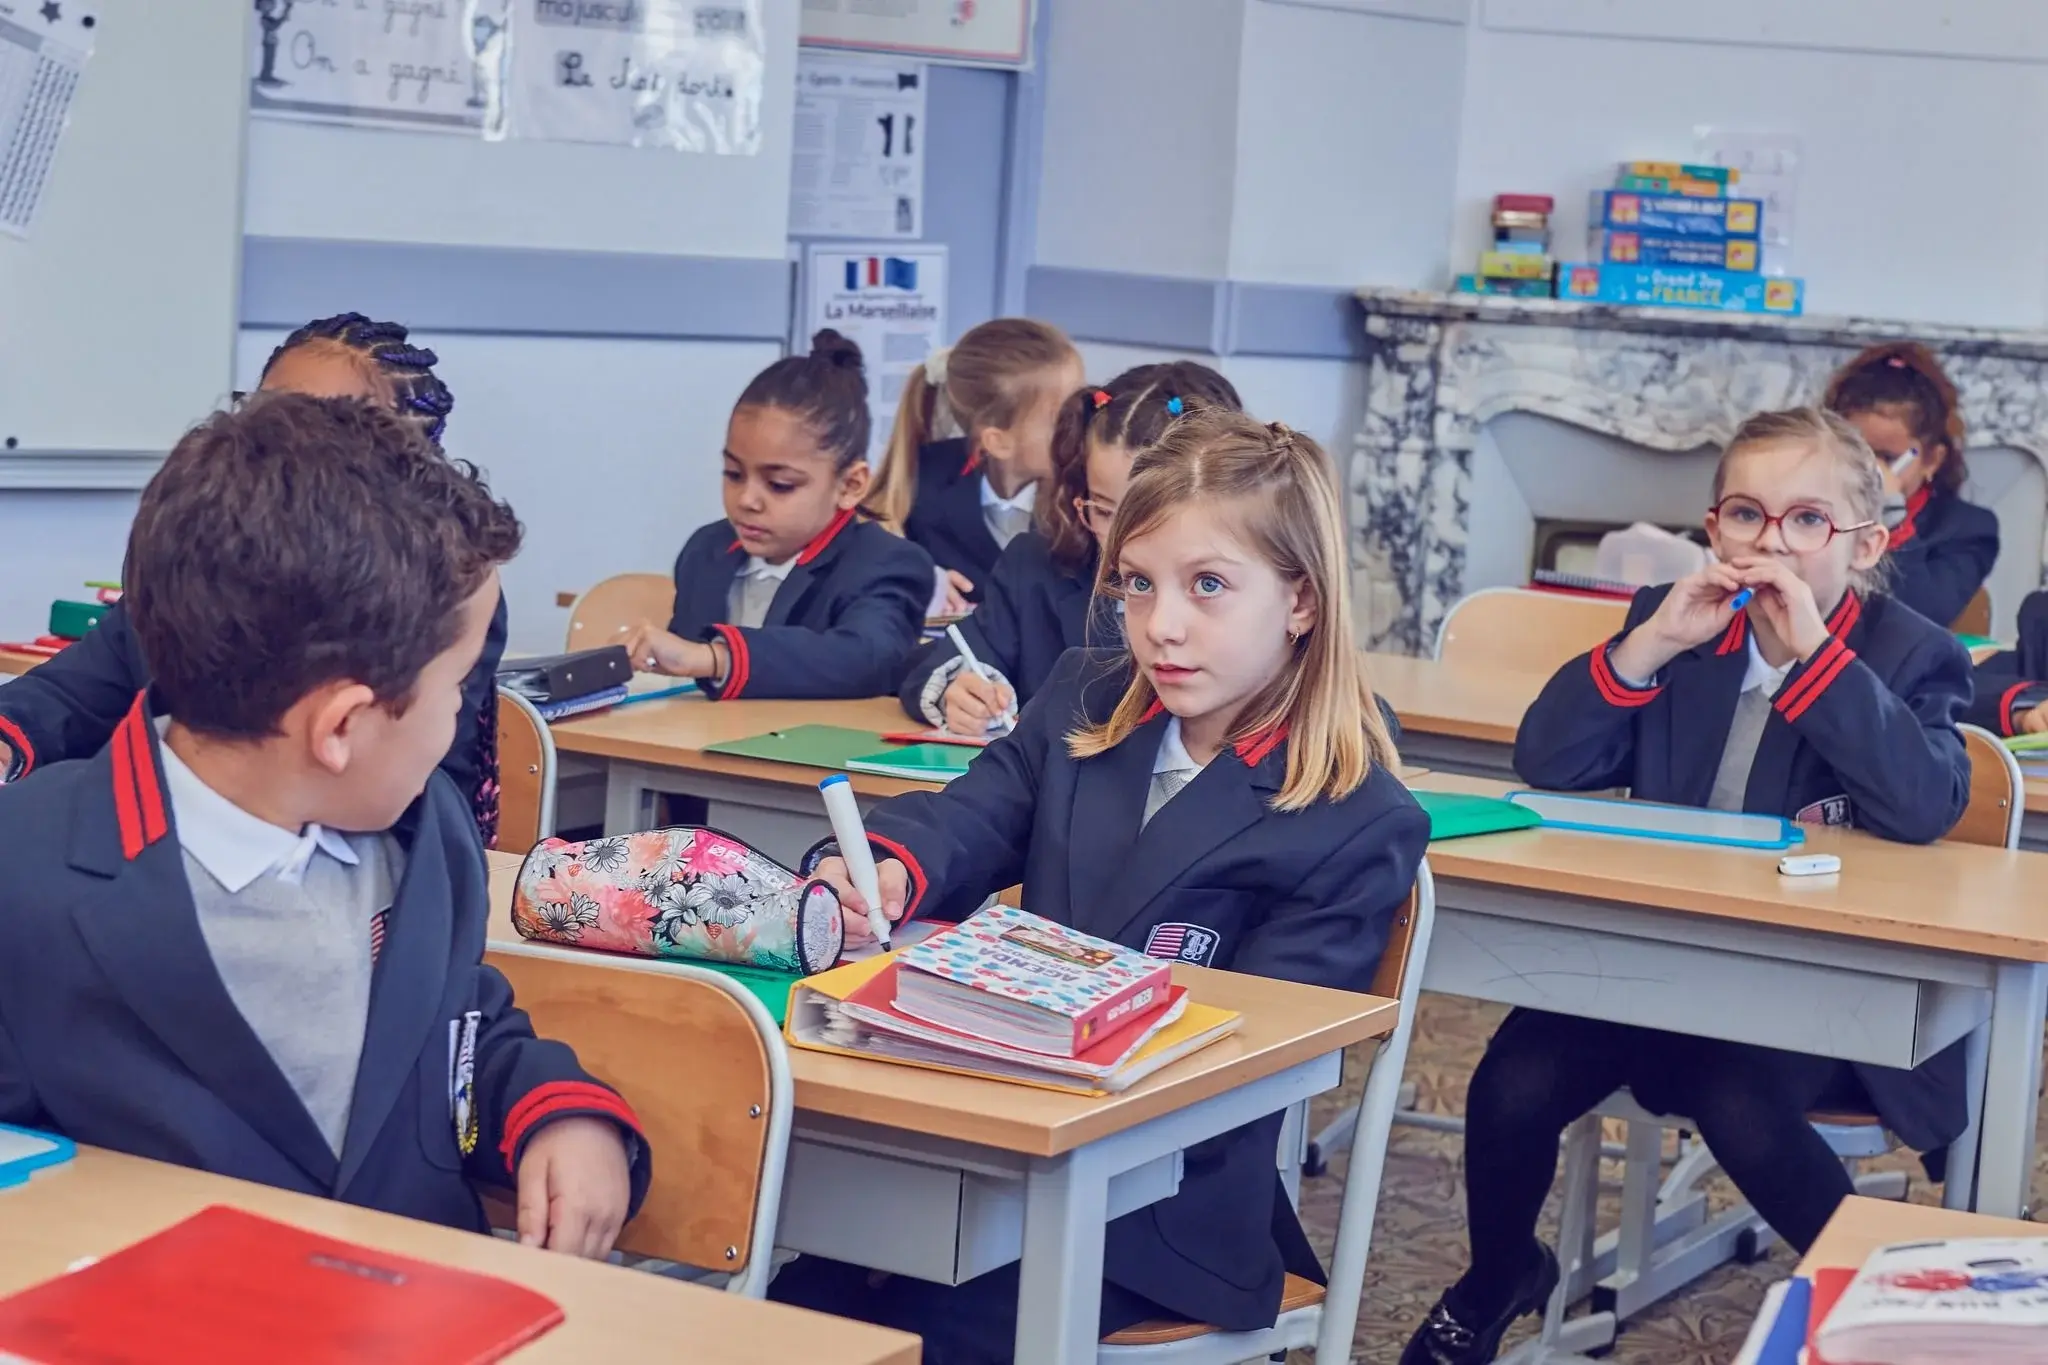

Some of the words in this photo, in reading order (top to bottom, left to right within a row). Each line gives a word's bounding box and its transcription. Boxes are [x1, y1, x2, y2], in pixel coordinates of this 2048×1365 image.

[291, 30, 339, 72] On
[353, 59, 372, 76] a
[825, 302, 843, 320] La
[848, 302, 937, 320] Marseillaise
[978, 947, 1080, 983] AGENDA
